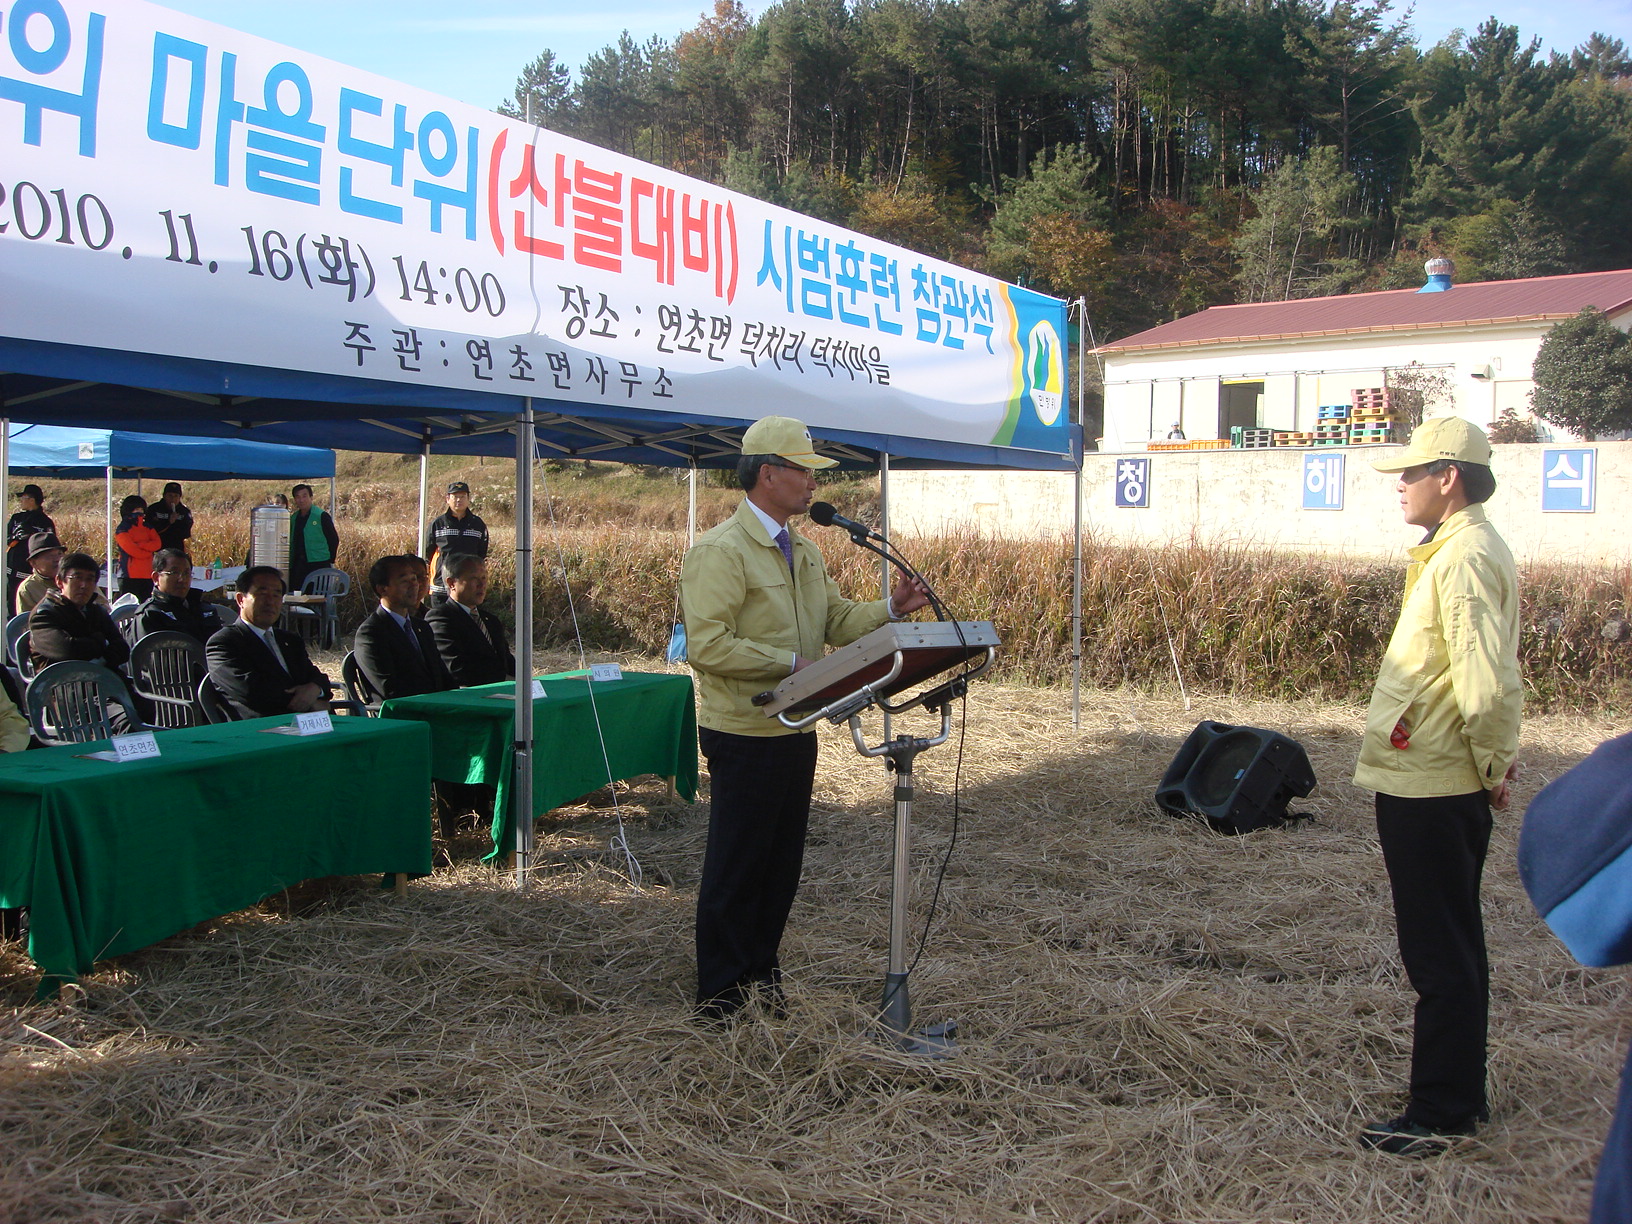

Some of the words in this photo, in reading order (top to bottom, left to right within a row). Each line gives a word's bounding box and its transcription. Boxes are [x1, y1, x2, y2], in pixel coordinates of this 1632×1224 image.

[0, 0, 106, 158] 위
[147, 31, 739, 305] 마을단위(산불대비)
[757, 219, 903, 336] 시범훈련
[911, 263, 994, 355] 참관석
[0, 181, 132, 260] 010.
[159, 209, 218, 274] 11.
[240, 225, 376, 302] 16(화)
[392, 255, 506, 317] 14:00
[557, 284, 619, 339] 장소
[657, 304, 732, 362] 연초면
[740, 321, 804, 374] 덕치리
[810, 336, 890, 386] 덕치마을
[1118, 461, 1145, 503] 청
[1306, 458, 1340, 505] 해
[1546, 453, 1591, 507] 식
[118, 740, 157, 757] 연초면장
[300, 716, 330, 731] 거제시장
